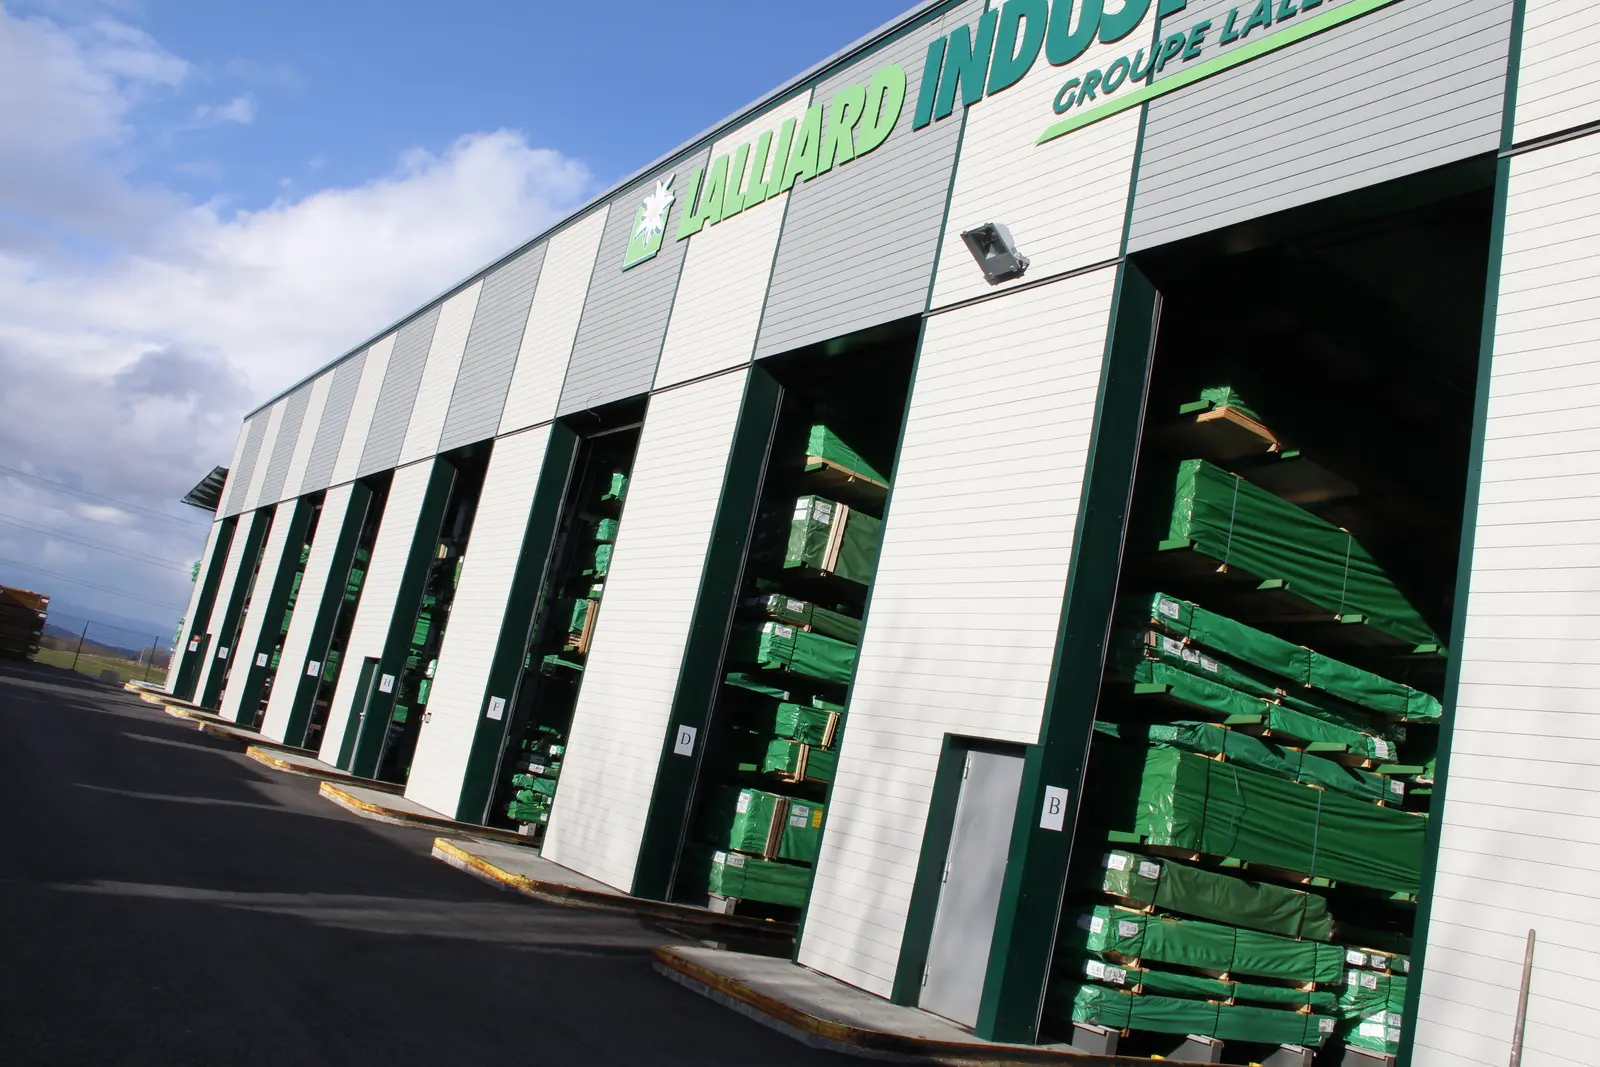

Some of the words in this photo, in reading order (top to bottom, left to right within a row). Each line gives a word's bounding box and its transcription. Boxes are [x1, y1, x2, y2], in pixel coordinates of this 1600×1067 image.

[1052, 20, 1212, 115] GROUPE
[676, 64, 907, 243] LALLIARD
[912, 0, 1187, 132] INDU
[383, 678, 392, 688] H
[492, 702, 501, 711] F
[680, 732, 692, 746] D
[1048, 796, 1061, 815] B
